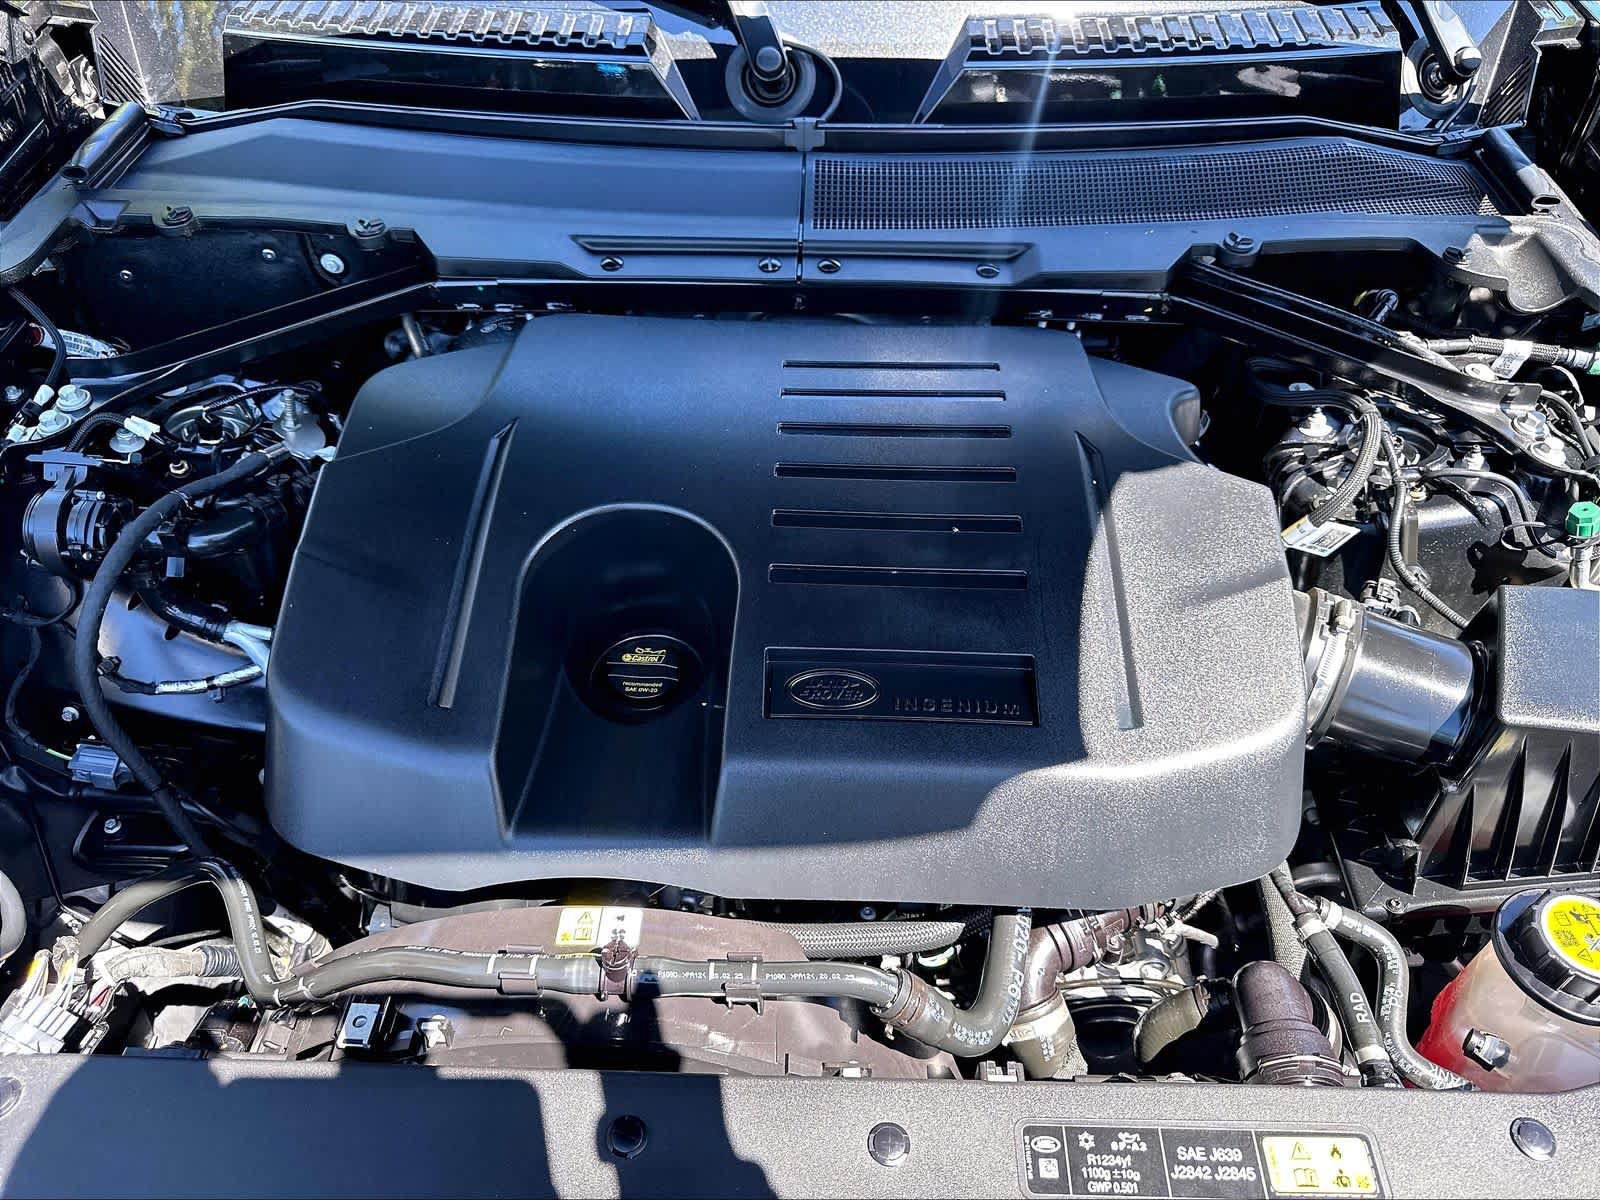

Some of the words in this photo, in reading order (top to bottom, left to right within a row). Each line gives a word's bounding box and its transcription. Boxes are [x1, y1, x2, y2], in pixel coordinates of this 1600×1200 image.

[895, 696, 1021, 715] INGENIUM
[1350, 992, 1371, 1023] RAD
[1086, 1153, 1132, 1169] R1234yf
[1176, 1146, 1207, 1161] SAE
[1209, 1147, 1243, 1162] J639
[1081, 1166, 1112, 1181] 1100g
[1170, 1164, 1213, 1180] J2842
[1214, 1165, 1257, 1182] J2845
[1087, 1180, 1112, 1193] GWP
